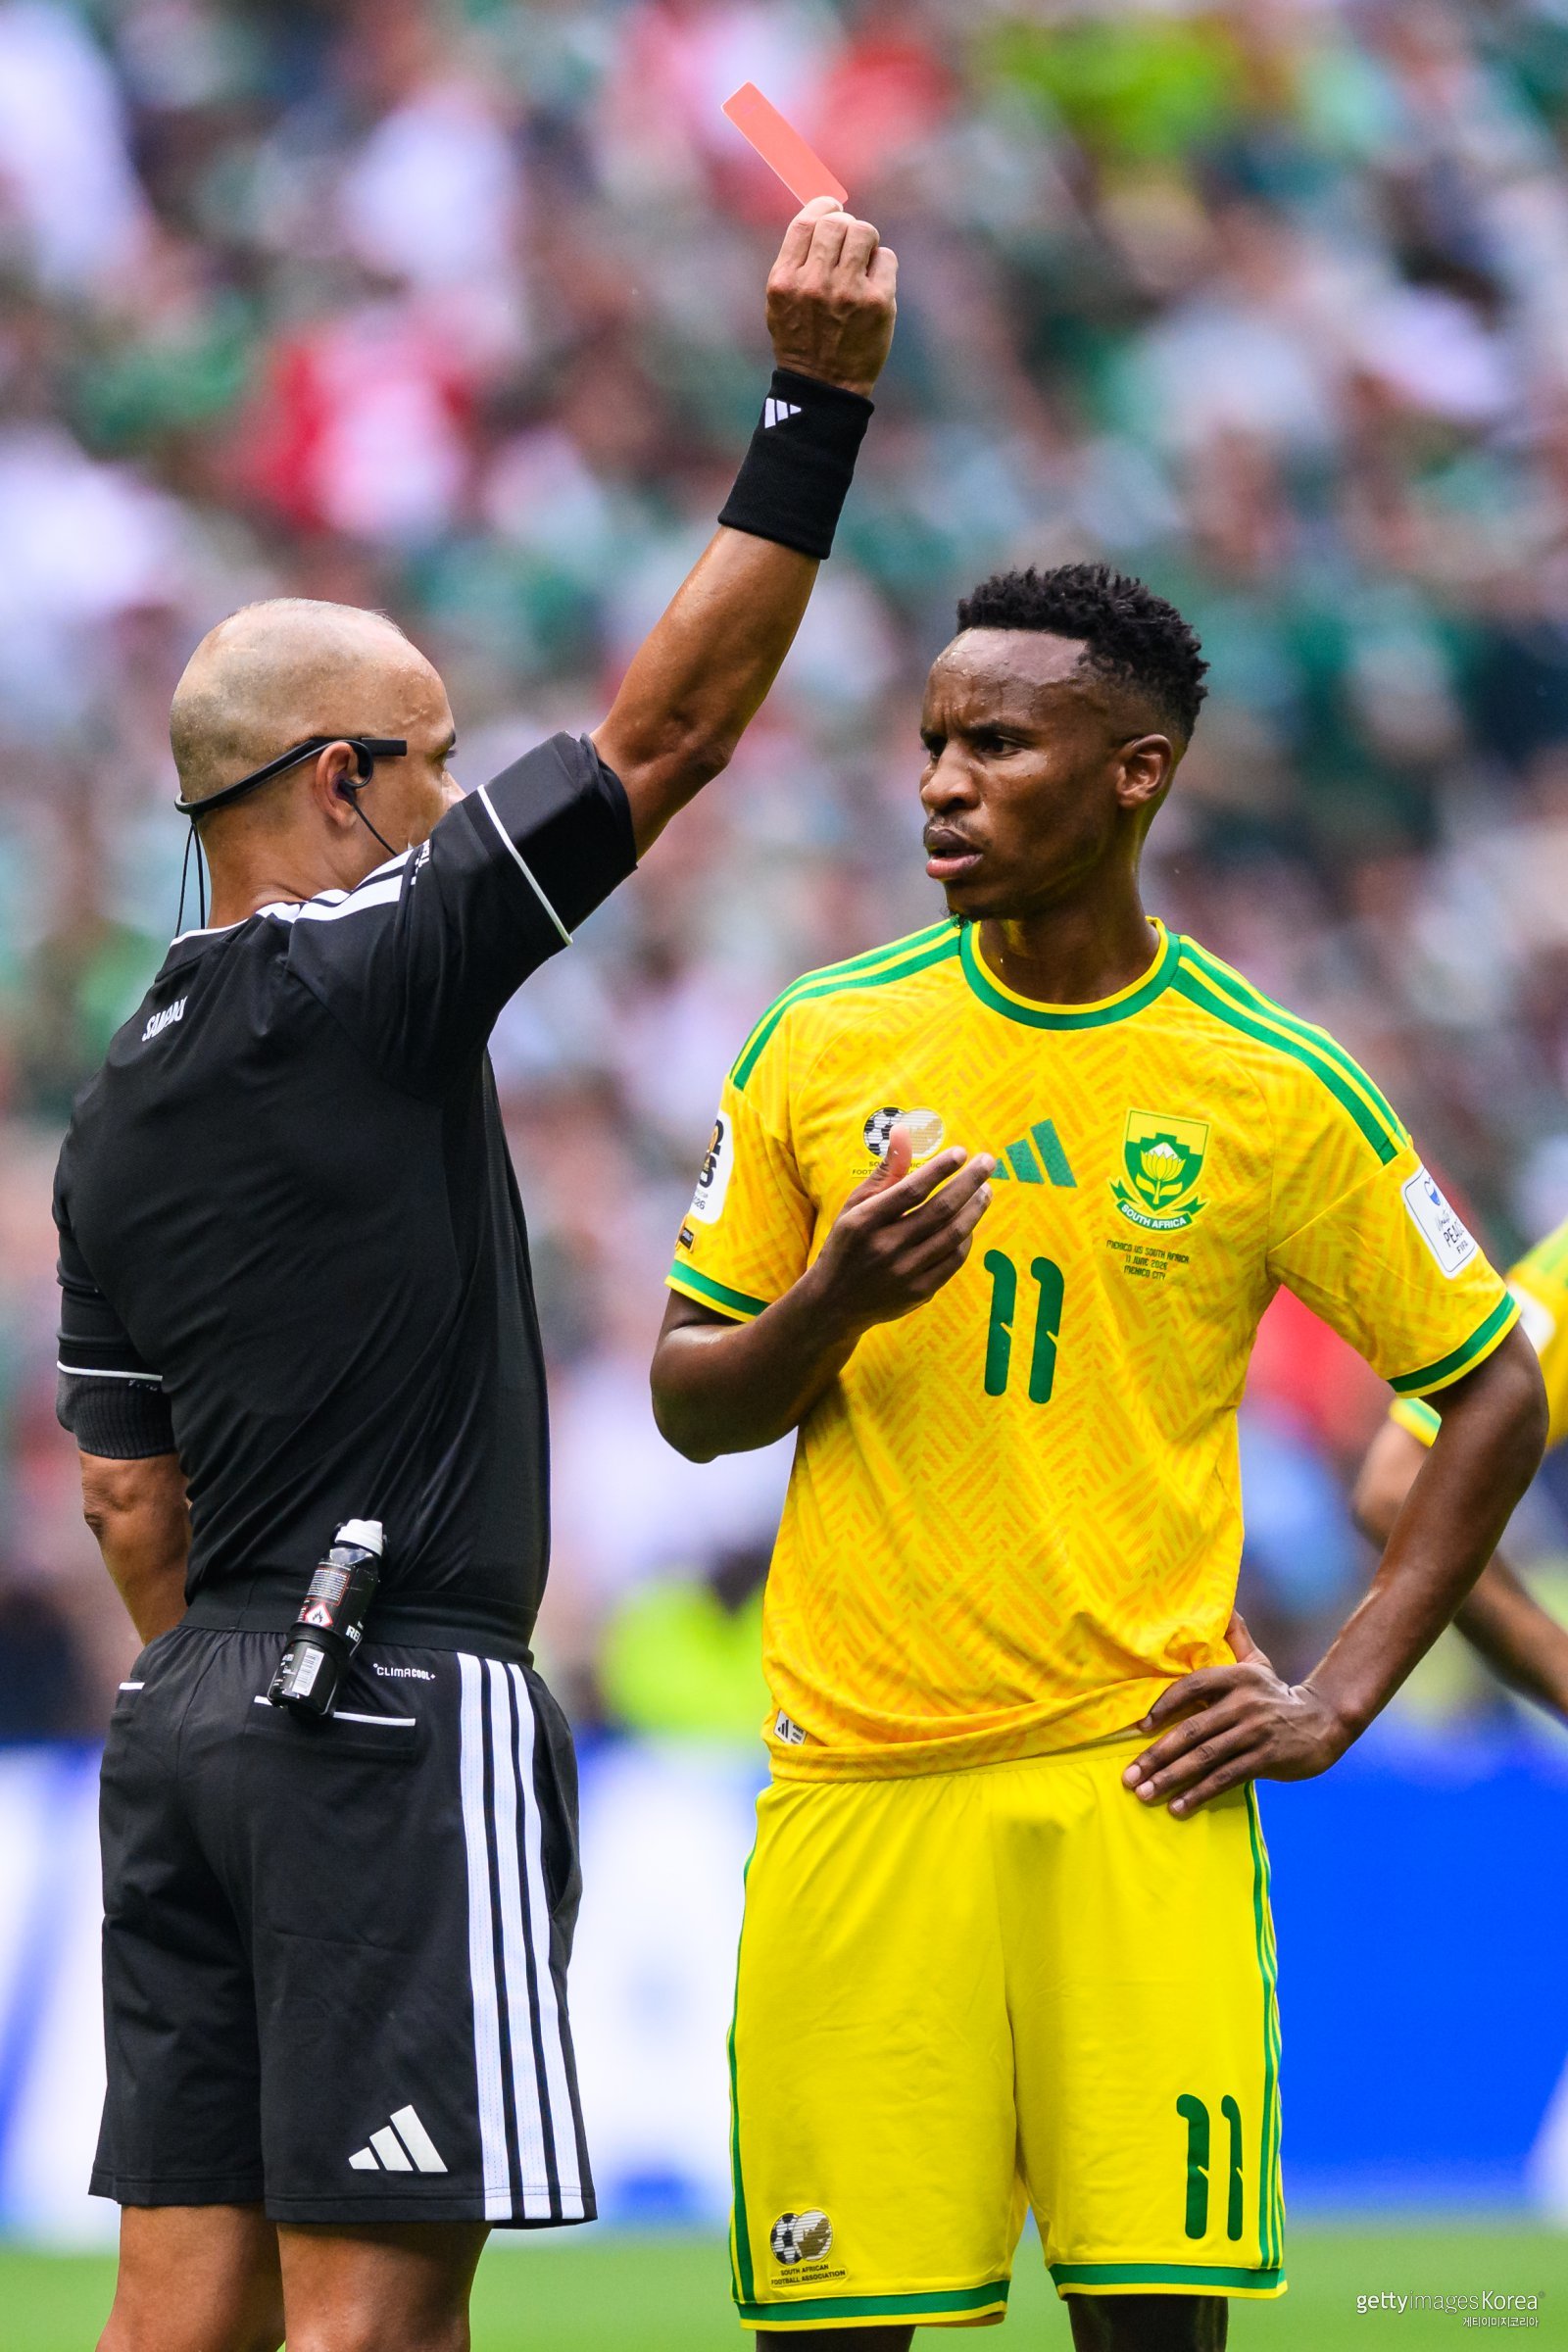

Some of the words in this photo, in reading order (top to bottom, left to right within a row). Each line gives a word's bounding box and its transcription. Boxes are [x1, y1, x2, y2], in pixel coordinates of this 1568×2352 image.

[1121, 1203, 1151, 1227] SOUTH
[1152, 1216, 1187, 1229] AFRICA
[1106, 1239, 1133, 1252] MEXICO
[1145, 1247, 1166, 1259] SOUTH
[1167, 1250, 1190, 1264] AFRICA
[1123, 1264, 1151, 1278] MEXICO
[1152, 1270, 1166, 1281] CITY
[1133, 1255, 1150, 1267] JUNE
[1151, 1259, 1168, 1271] 2026
[984, 1249, 1065, 1404] 11
[1176, 2093, 1244, 2242] 11
[770, 2276, 800, 2286] FOOTBALL
[801, 2269, 846, 2282] ASSOCIATION
[780, 2267, 801, 2277] SOUTH
[802, 2264, 829, 2274] AFRICAN
